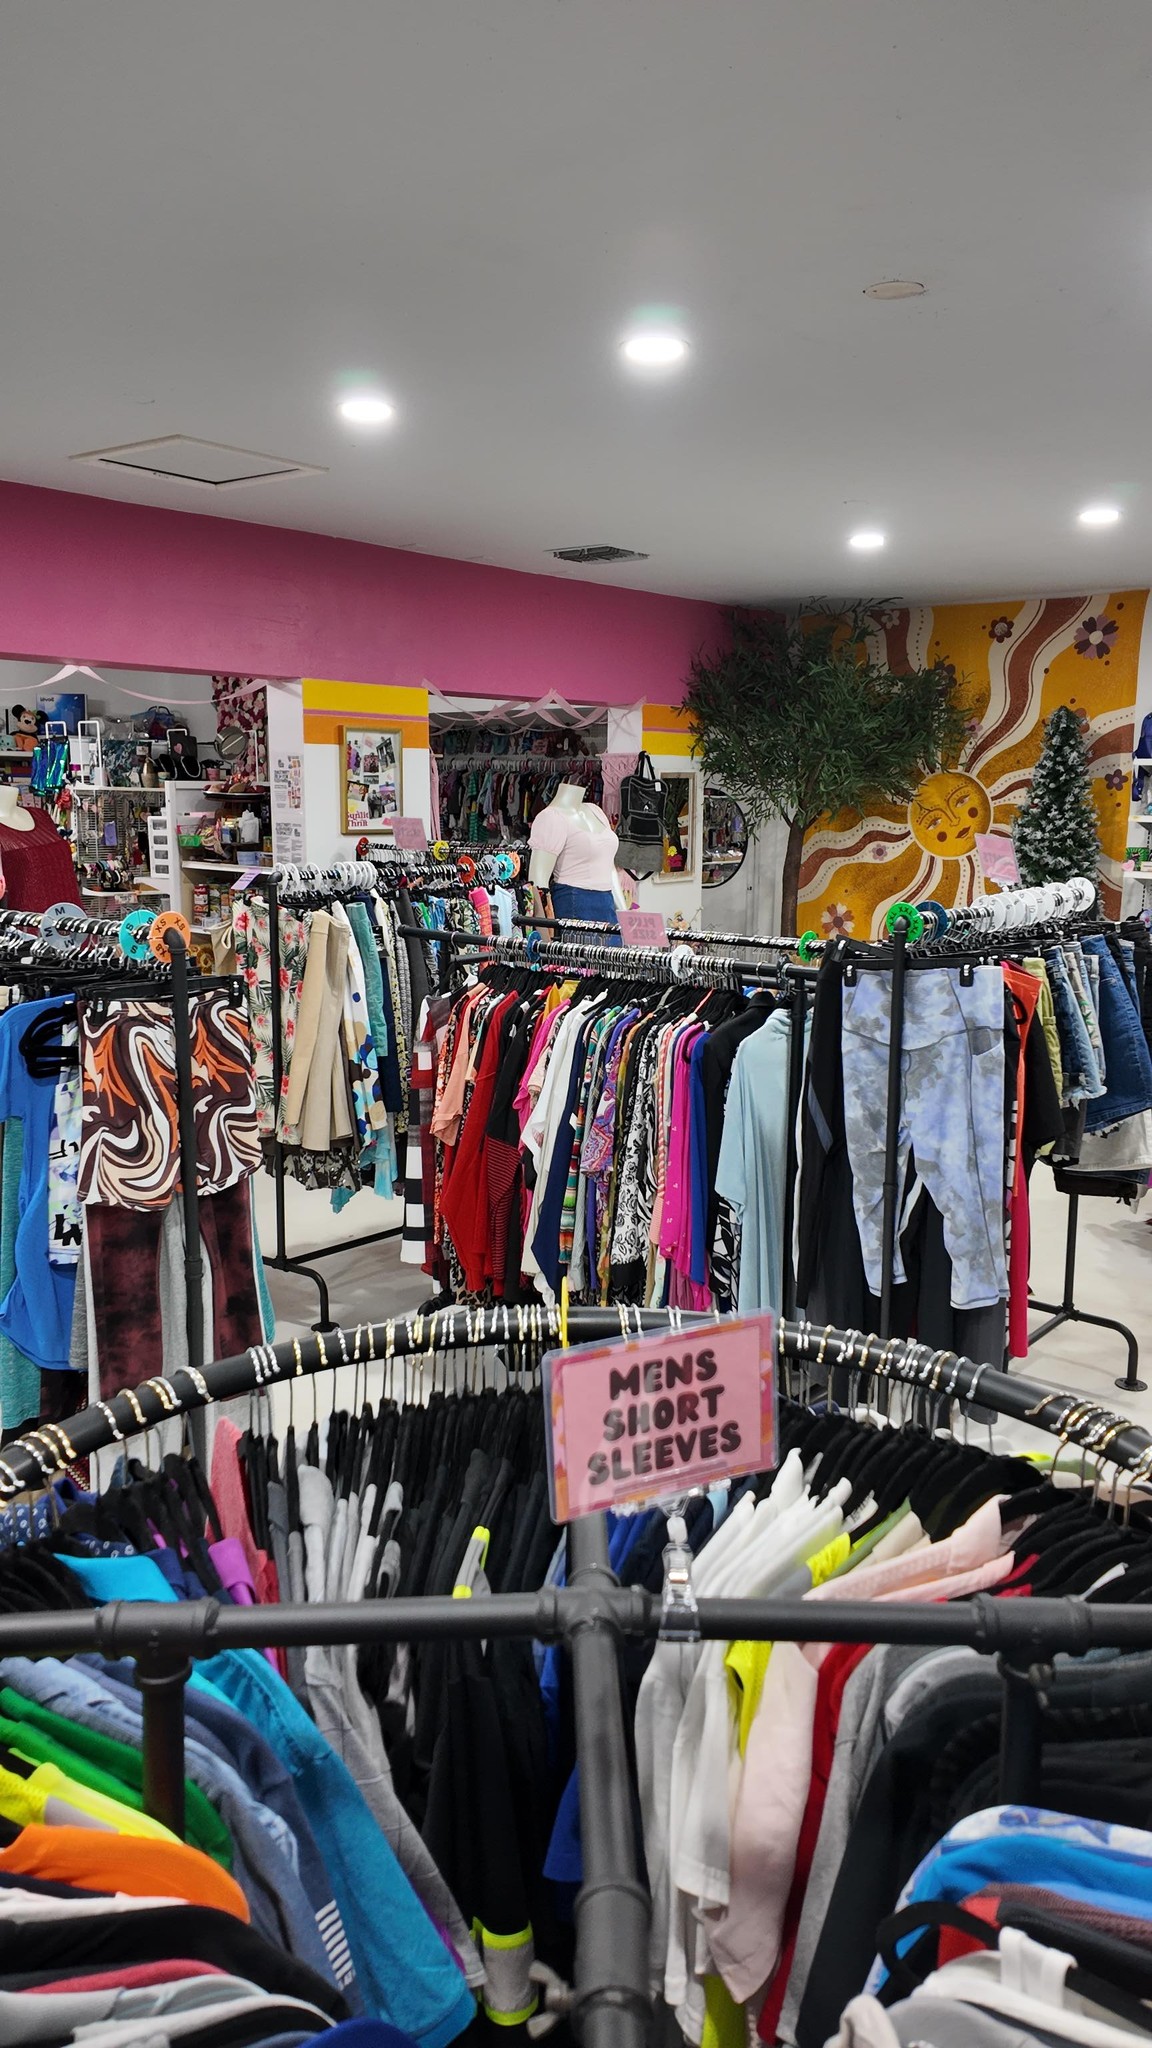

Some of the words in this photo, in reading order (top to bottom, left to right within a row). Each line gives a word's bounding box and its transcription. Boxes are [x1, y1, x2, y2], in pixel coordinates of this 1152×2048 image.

[54, 906, 66, 916] M
[125, 922, 134, 932] S
[155, 918, 167, 933] XS
[43, 927, 54, 938] M
[130, 944, 138, 954] S
[609, 1348, 718, 1400] MENS
[602, 1384, 725, 1441] SHORT
[587, 1420, 742, 1486] SLEEVES
